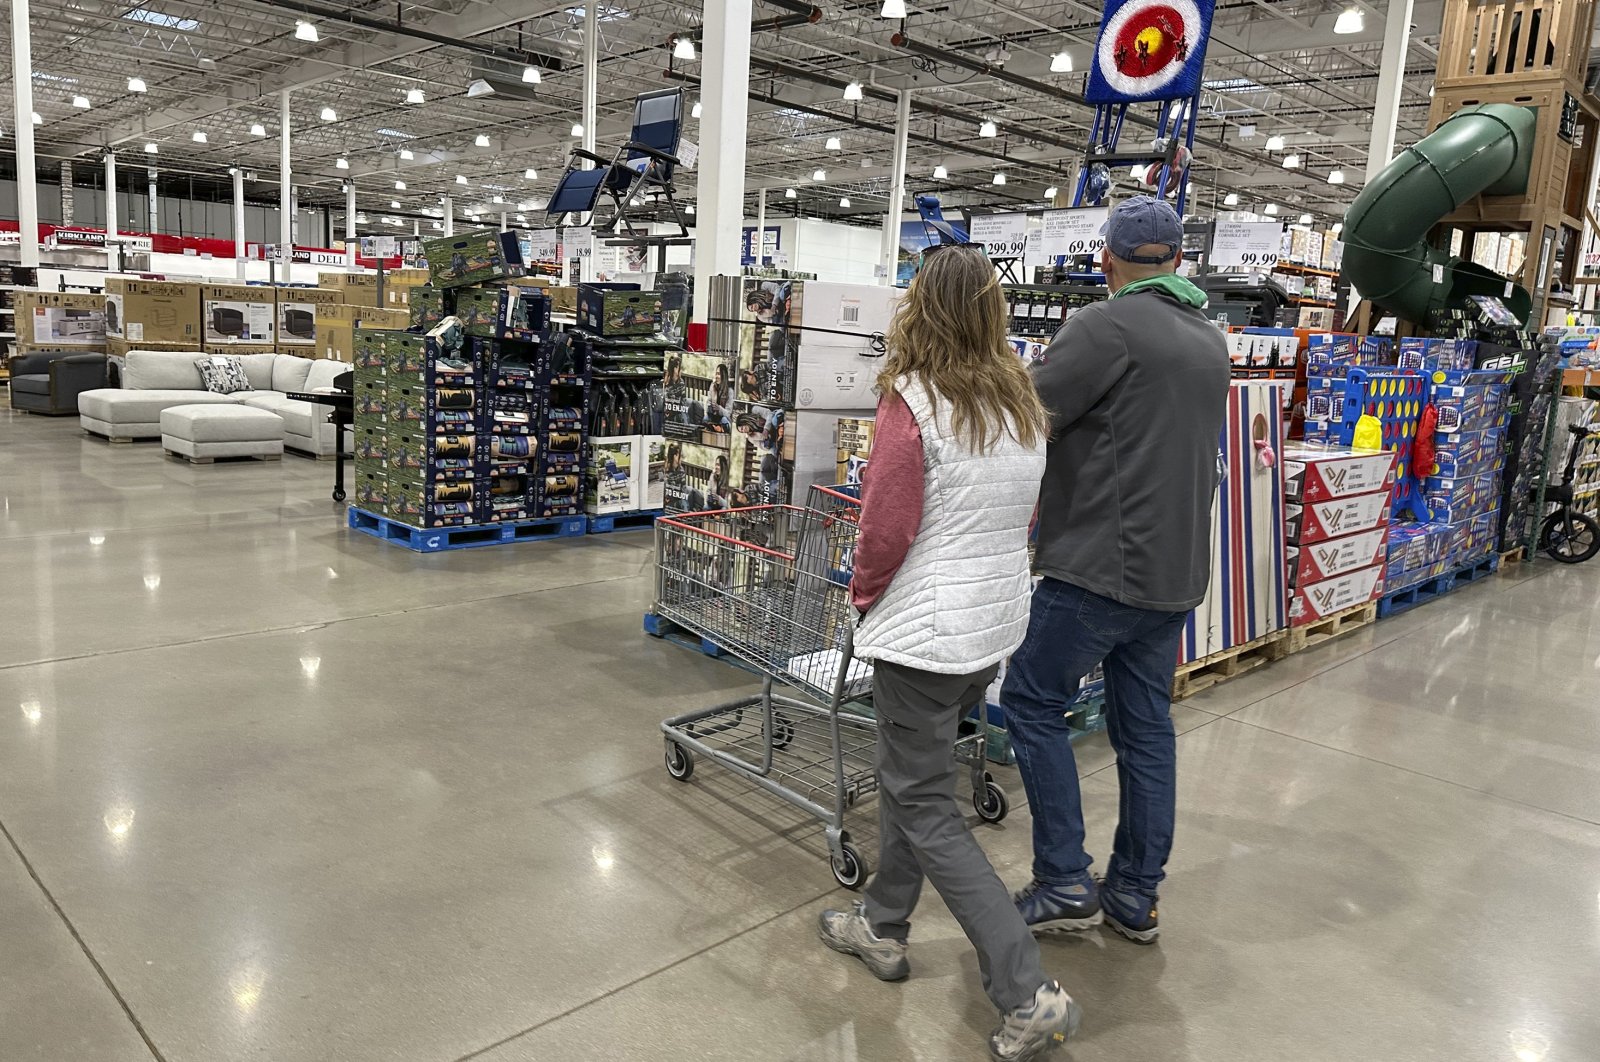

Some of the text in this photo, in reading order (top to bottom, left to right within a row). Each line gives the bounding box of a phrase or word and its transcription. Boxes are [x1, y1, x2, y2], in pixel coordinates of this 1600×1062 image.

[58, 232, 104, 241] KIRKLAND
[575, 247, 592, 257] 18.99
[987, 241, 1024, 255] 299.99
[1068, 239, 1106, 253] 69.99
[317, 254, 343, 265] DELI
[1240, 252, 1278, 266] 99.99
[1481, 353, 1526, 371] GEL
[664, 403, 690, 413] TO ENJOY
[665, 488, 689, 500] TO ENJOY
